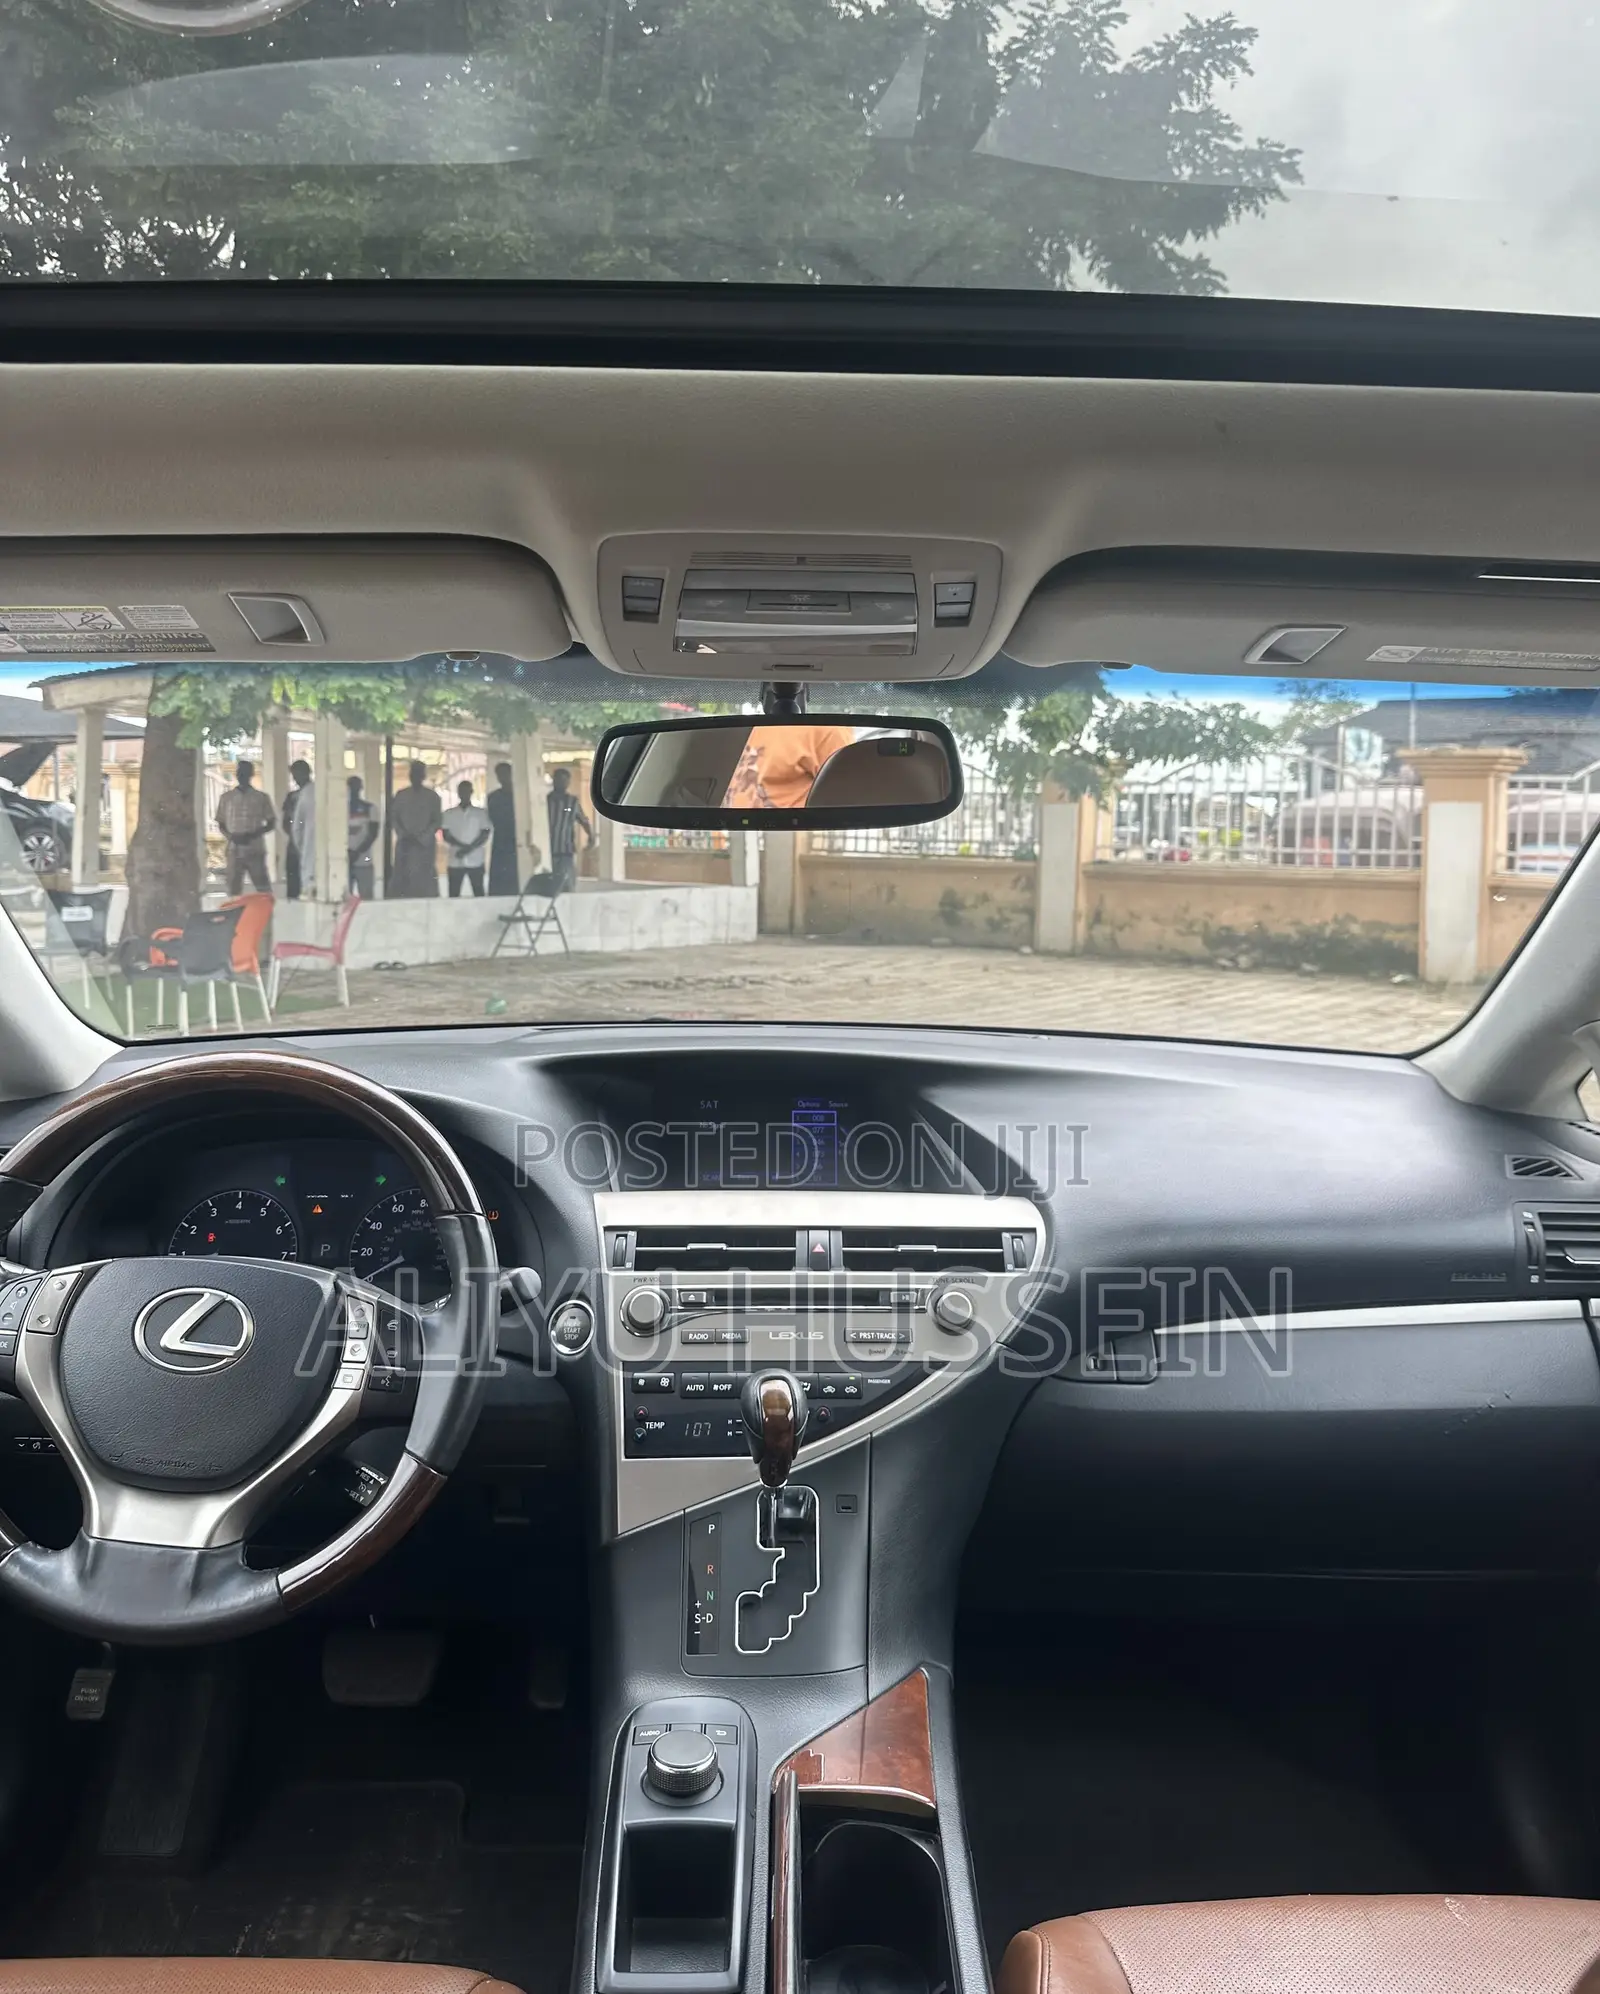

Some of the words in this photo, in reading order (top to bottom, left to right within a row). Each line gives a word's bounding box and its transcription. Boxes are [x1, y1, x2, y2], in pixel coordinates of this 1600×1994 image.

[104, 632, 204, 640] WARNING
[700, 1100, 719, 1110] SAT
[235, 1201, 243, 1210] 4
[391, 1203, 405, 1213] 60
[210, 1207, 218, 1217] 3
[259, 1207, 267, 1217] 5
[189, 1225, 198, 1235] 2
[275, 1226, 283, 1235] 6
[369, 1221, 383, 1231] 40
[320, 1243, 332, 1257] P
[360, 1247, 374, 1257] 20
[281, 1251, 288, 1261] 7
[564, 1333, 579, 1341] STOP
[688, 1333, 709, 1341] RADIO
[721, 1332, 742, 1341] MEDIA
[768, 1331, 825, 1340] LEXUS
[686, 1384, 705, 1392] AUTO
[719, 1383, 733, 1391] OFF
[645, 1421, 666, 1430] TEMP
[708, 1523, 716, 1535] P
[707, 1564, 714, 1575] R
[706, 1590, 714, 1601] N
[639, 1730, 661, 1738] AUDIO
